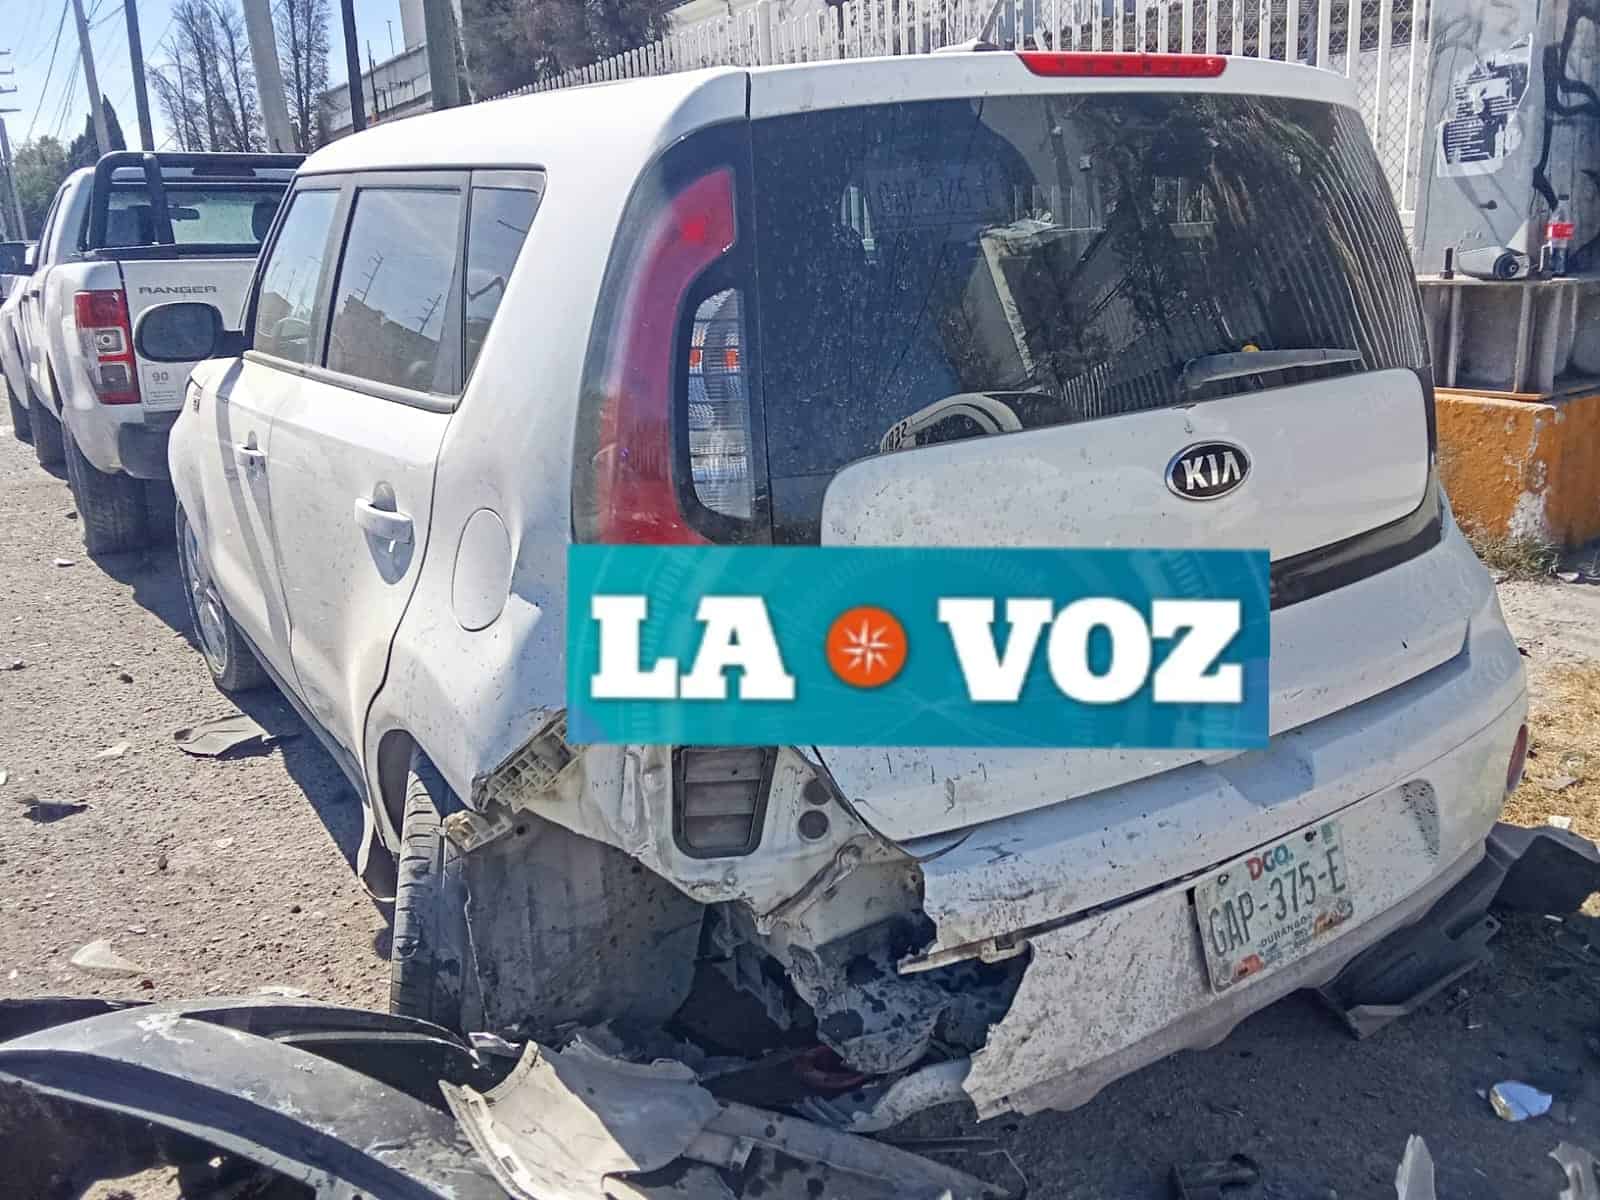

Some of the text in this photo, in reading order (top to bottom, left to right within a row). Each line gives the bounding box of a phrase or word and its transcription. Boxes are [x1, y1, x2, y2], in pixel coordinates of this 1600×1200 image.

[138, 286, 217, 295] RANGER
[152, 371, 169, 382] 90
[1181, 451, 1241, 490] KIA
[1209, 845, 1346, 957] GAP-375-E
